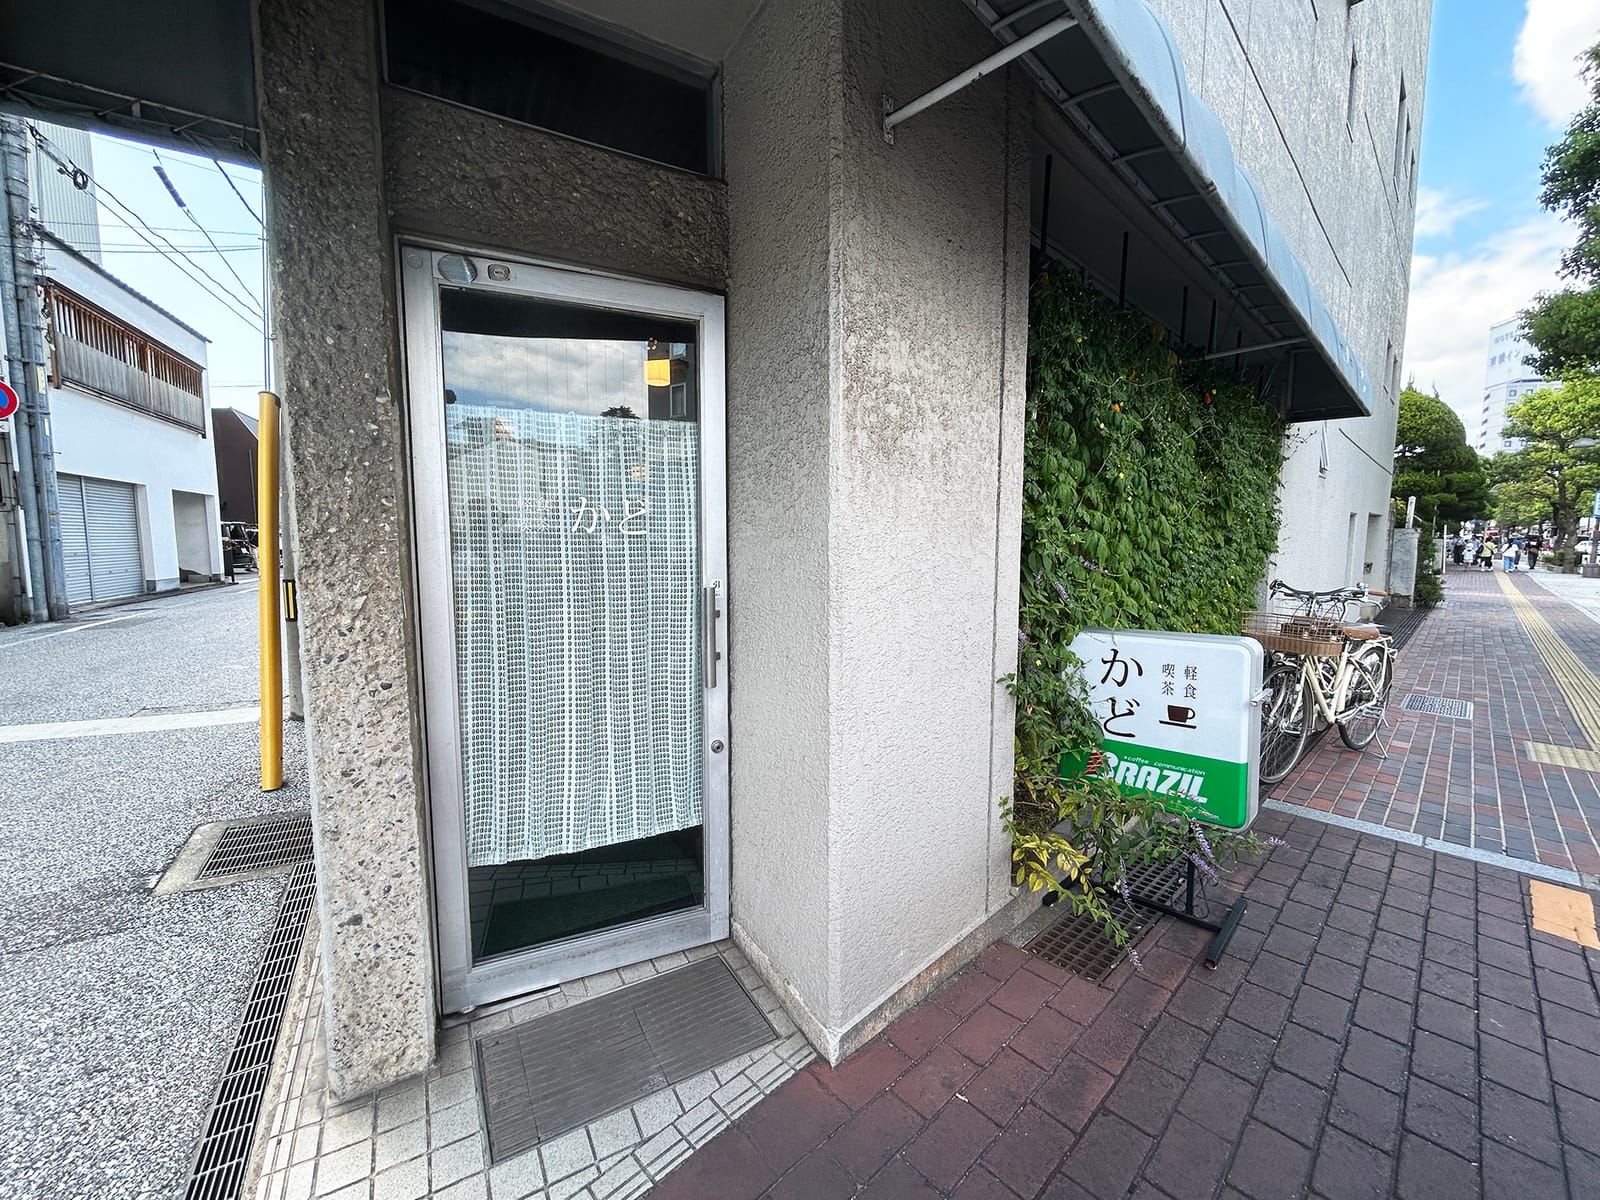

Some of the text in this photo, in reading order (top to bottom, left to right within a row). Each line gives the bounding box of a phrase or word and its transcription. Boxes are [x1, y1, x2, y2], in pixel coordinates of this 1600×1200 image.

[571, 496, 648, 534] かど
[1101, 648, 1143, 738] かど
[1162, 663, 1176, 696] 喫茶
[1184, 664, 1198, 699] 軽食
[1085, 750, 1208, 803] BRAZIL
[1127, 756, 1206, 776] coffee communication
